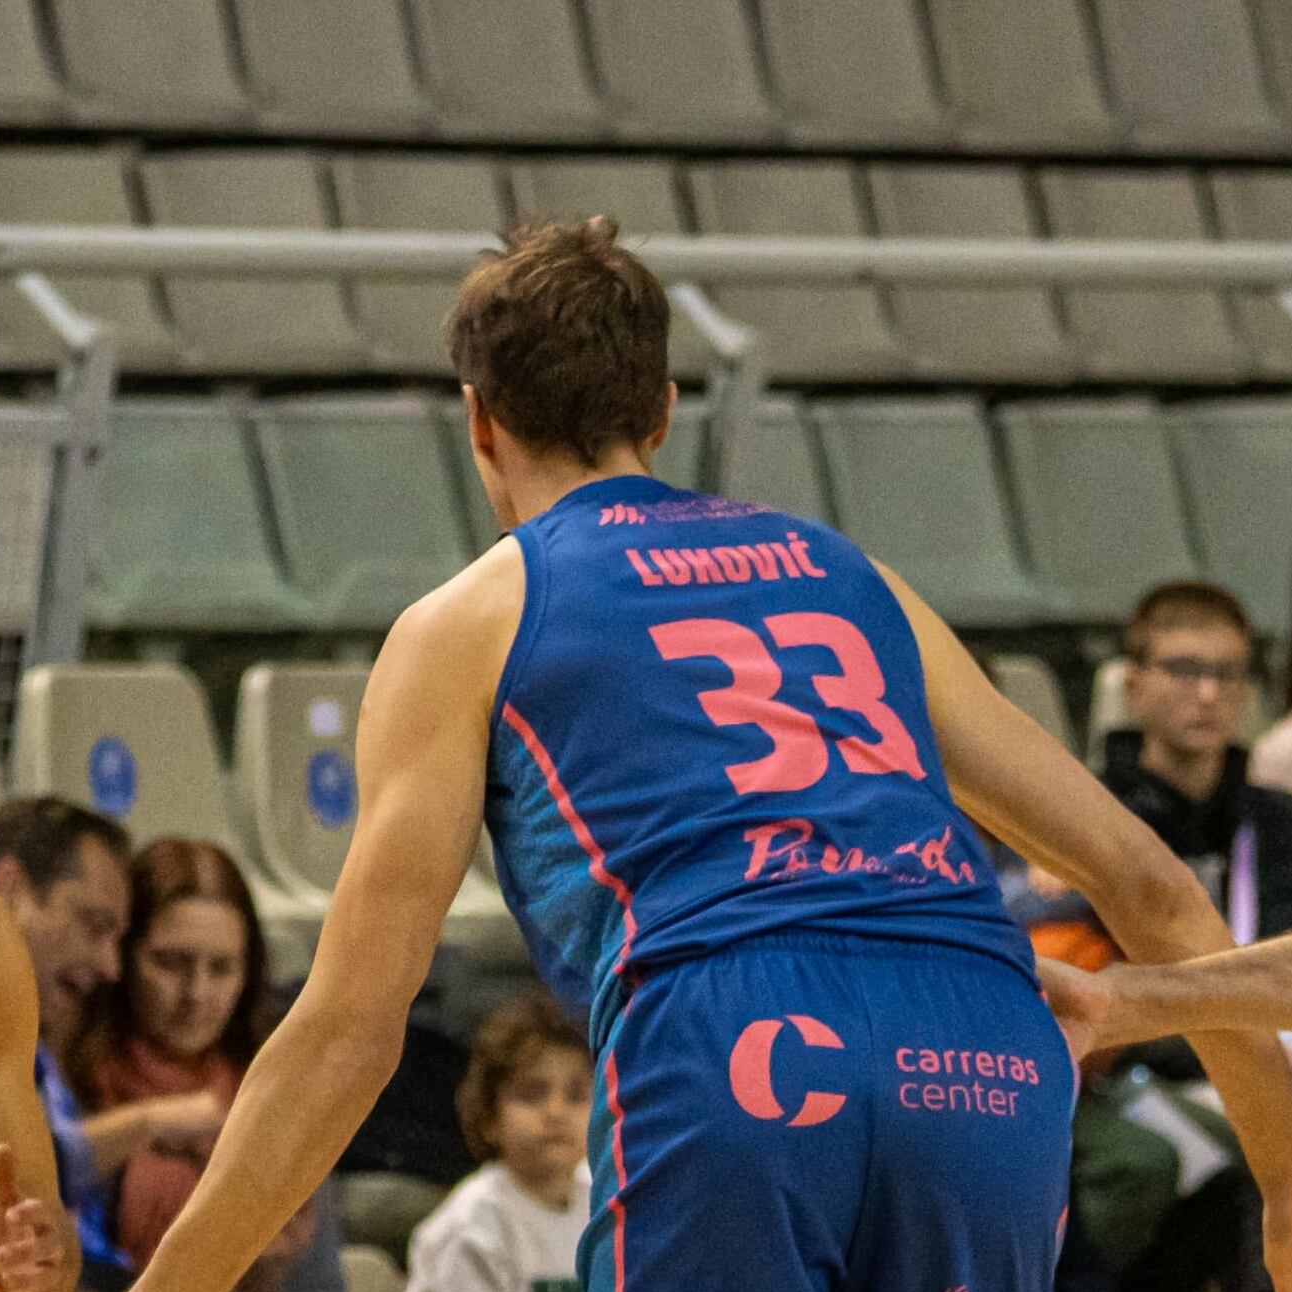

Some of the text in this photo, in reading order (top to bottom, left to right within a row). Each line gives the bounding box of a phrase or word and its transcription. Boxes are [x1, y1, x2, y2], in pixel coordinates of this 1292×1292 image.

[647, 611, 928, 796] 33
[896, 1047, 1040, 1085] carreras
[899, 1080, 1020, 1117] center
